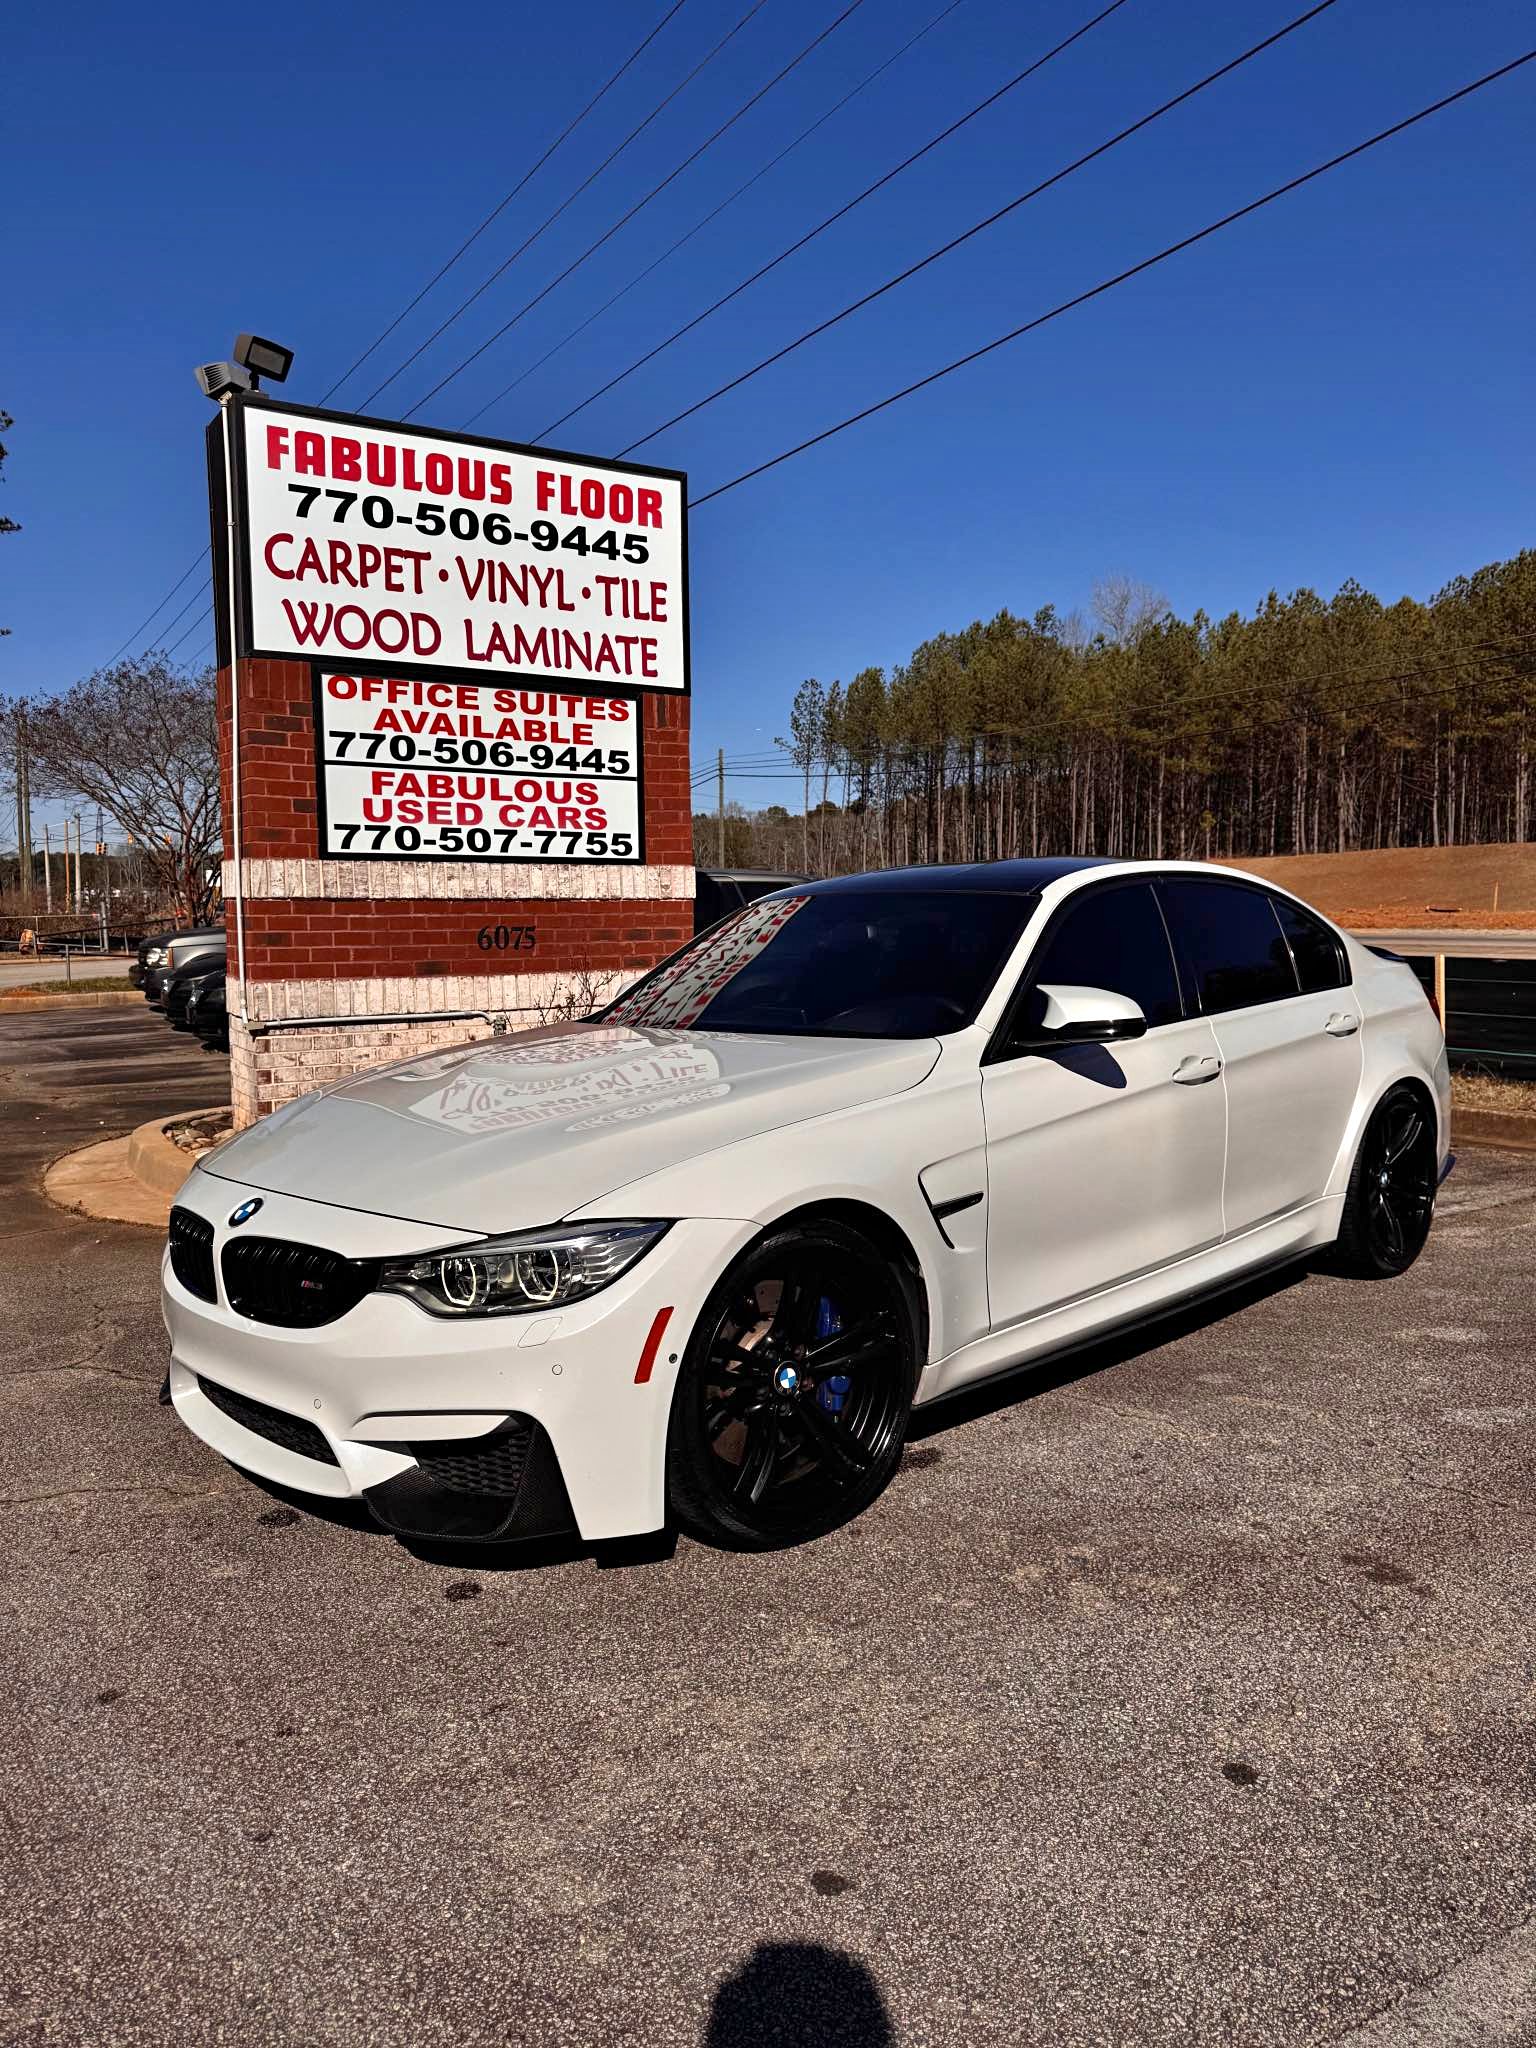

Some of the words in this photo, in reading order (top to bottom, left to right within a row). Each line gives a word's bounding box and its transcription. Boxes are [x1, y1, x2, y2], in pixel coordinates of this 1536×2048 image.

[266, 424, 513, 506] FABULOUS
[536, 470, 663, 529] FLOOR
[287, 483, 650, 565] 770-506-9445
[264, 532, 432, 595] CARPET
[454, 555, 576, 612] VINYL
[595, 574, 668, 623] TILE
[280, 598, 442, 657] WOOD
[463, 618, 659, 678] LAMINATE
[327, 675, 480, 711] OFFICE
[493, 688, 630, 721] SUITES
[373, 708, 594, 746] AVAILABLE
[328, 730, 630, 775] 770-506-9445
[371, 770, 599, 806] FABULOUS
[362, 797, 484, 827] USED
[498, 804, 608, 831] CARS
[333, 823, 633, 857] 770-507-7755
[477, 925, 536, 951] 6075
